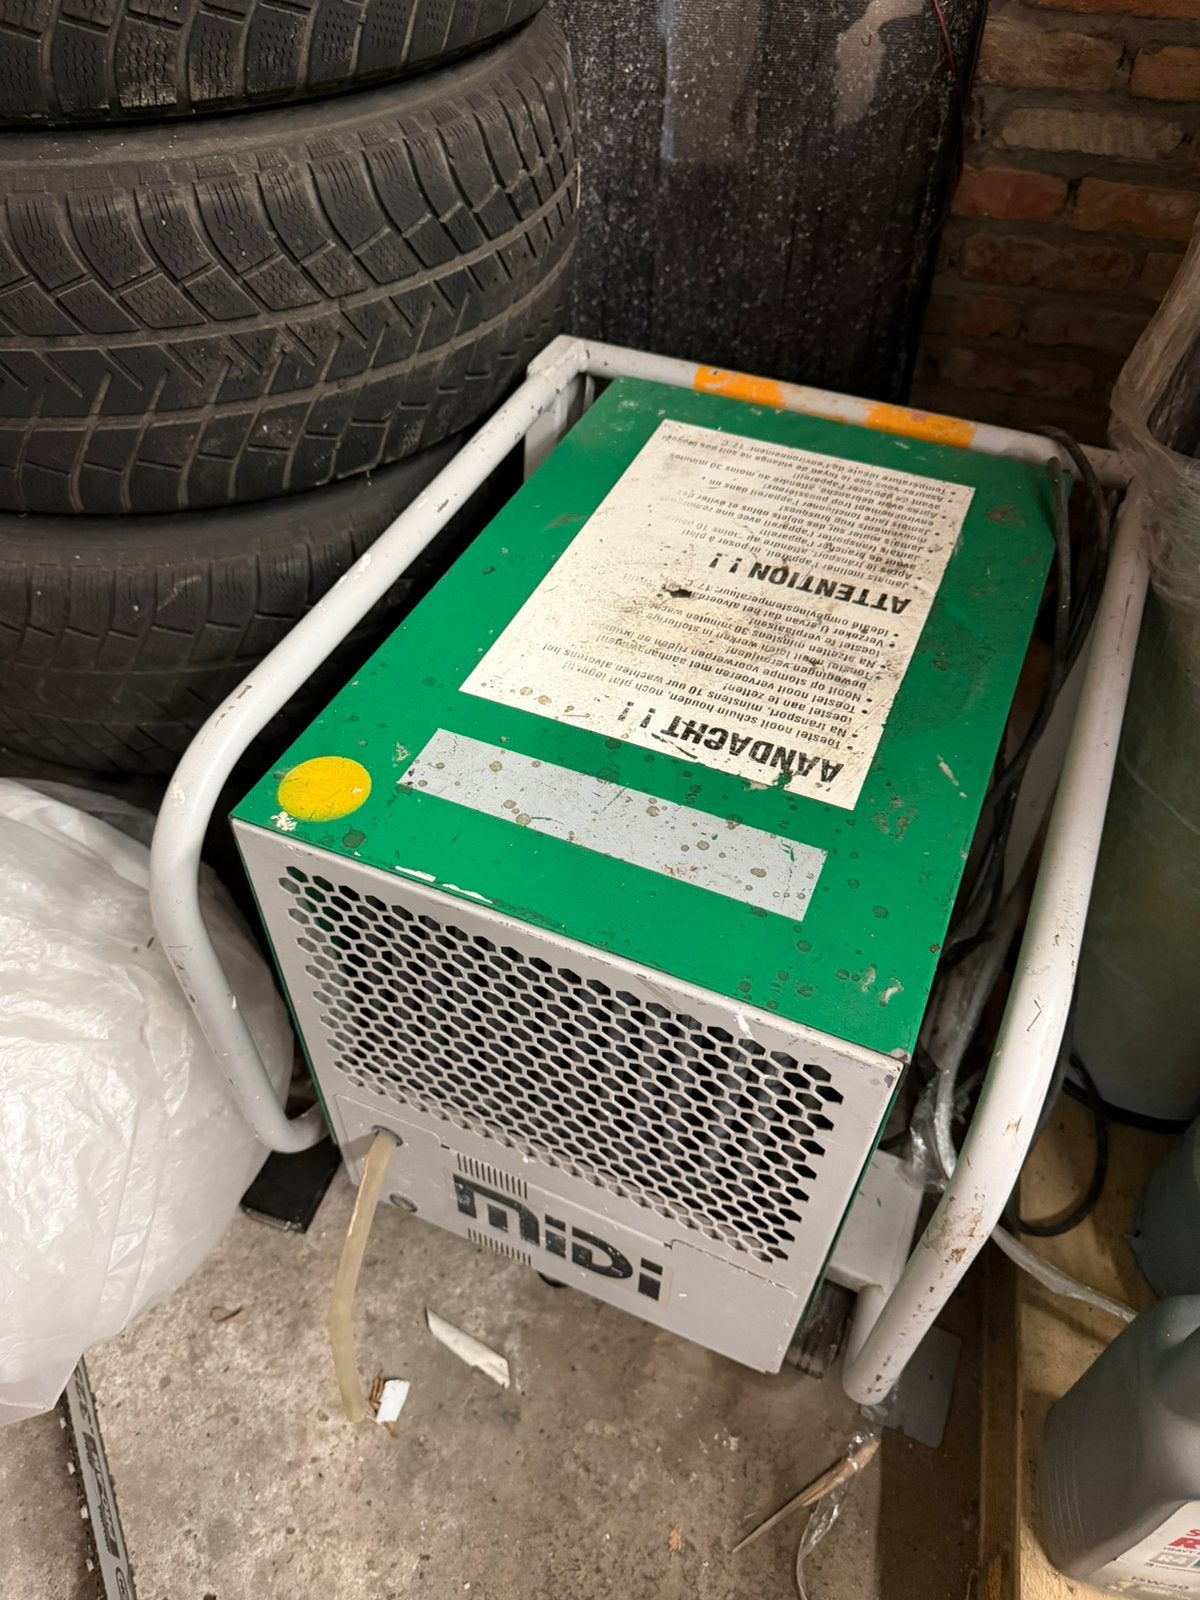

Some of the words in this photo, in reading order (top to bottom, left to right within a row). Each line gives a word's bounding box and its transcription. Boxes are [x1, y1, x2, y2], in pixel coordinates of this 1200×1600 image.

[752, 453, 795, 468] vidange
[794, 464, 809, 472] de
[723, 465, 756, 477] moins
[756, 472, 771, 480] au
[722, 482, 749, 493] dans
[771, 476, 815, 491] attendre
[852, 476, 873, 485] que
[695, 494, 727, 506] éviter
[748, 487, 801, 505] l'appareil
[829, 497, 853, 508] trop
[714, 507, 735, 516] une
[726, 501, 739, 509] et
[739, 504, 770, 516] obtus
[800, 500, 861, 519] fonctionner
[910, 498, 941, 510] avant
[736, 512, 762, 523] avec
[770, 510, 805, 524] objets
[777, 503, 832, 521] brusques!
[853, 503, 934, 527] environnement
[762, 518, 816, 536] l'appareil
[805, 520, 826, 529] des
[832, 516, 856, 527] trop
[862, 514, 889, 526] faire
[827, 525, 846, 533] sur
[856, 522, 928, 544] mouvements
[890, 521, 931, 536] Jamais
[716, 535, 749, 548] poser
[745, 534, 761, 542] au
[758, 527, 816, 546] l'appareil!
[815, 530, 878, 551] transporter
[749, 545, 762, 553] ni
[761, 538, 808, 554] attendre
[882, 538, 924, 553] Jamais
[707, 552, 723, 568] !
[866, 554, 883, 563] de
[878, 546, 920, 561] Jamais
[727, 556, 743, 573] !
[820, 562, 865, 578] incliner
[864, 563, 877, 571] le
[746, 561, 912, 616] ATTENTION
[865, 573, 909, 589] Jamais
[741, 604, 762, 614] het
[761, 609, 783, 620] dat
[684, 611, 733, 630] minuten
[784, 615, 818, 628] ervan
[819, 624, 830, 632] U
[700, 627, 713, 636] in
[732, 624, 750, 634] 30
[636, 633, 652, 642] en
[652, 636, 690, 653] rijden
[714, 631, 759, 648] werken
[750, 629, 806, 649] minstens
[823, 636, 836, 646] te
[831, 627, 885, 647] Verzeker
[806, 644, 856, 663] afzetten
[837, 640, 880, 658] toestel
[687, 659, 713, 672] met
[689, 646, 761, 672] voorwerpen
[792, 652, 824, 666] nooit
[857, 657, 876, 669] Na
[613, 664, 664, 684] wachten
[713, 666, 776, 689] vervoeren
[760, 666, 809, 686] stompe
[791, 662, 867, 690] bewegingen
[826, 661, 871, 679] Toestel
[607, 673, 634, 688] plat
[665, 678, 687, 689] uur
[809, 679, 827, 690] op
[632, 682, 664, 697] noch
[687, 685, 705, 696] 10
[721, 682, 765, 700] zetten!
[776, 684, 809, 700] nooit
[827, 685, 862, 701] Nooit
[663, 690, 716, 712] houden,
[705, 690, 764, 713] minstens
[765, 694, 780, 705] te
[780, 698, 806, 710] aan
[810, 694, 857, 713] Toestel
[616, 701, 635, 722] !
[638, 707, 657, 729] !
[715, 706, 759, 725] schuin
[763, 705, 827, 731] transport,
[807, 706, 852, 725] toestel
[758, 718, 794, 735] nooit
[828, 725, 848, 737] Na
[794, 728, 842, 749] Toestel
[658, 713, 845, 785] AANDACHT
